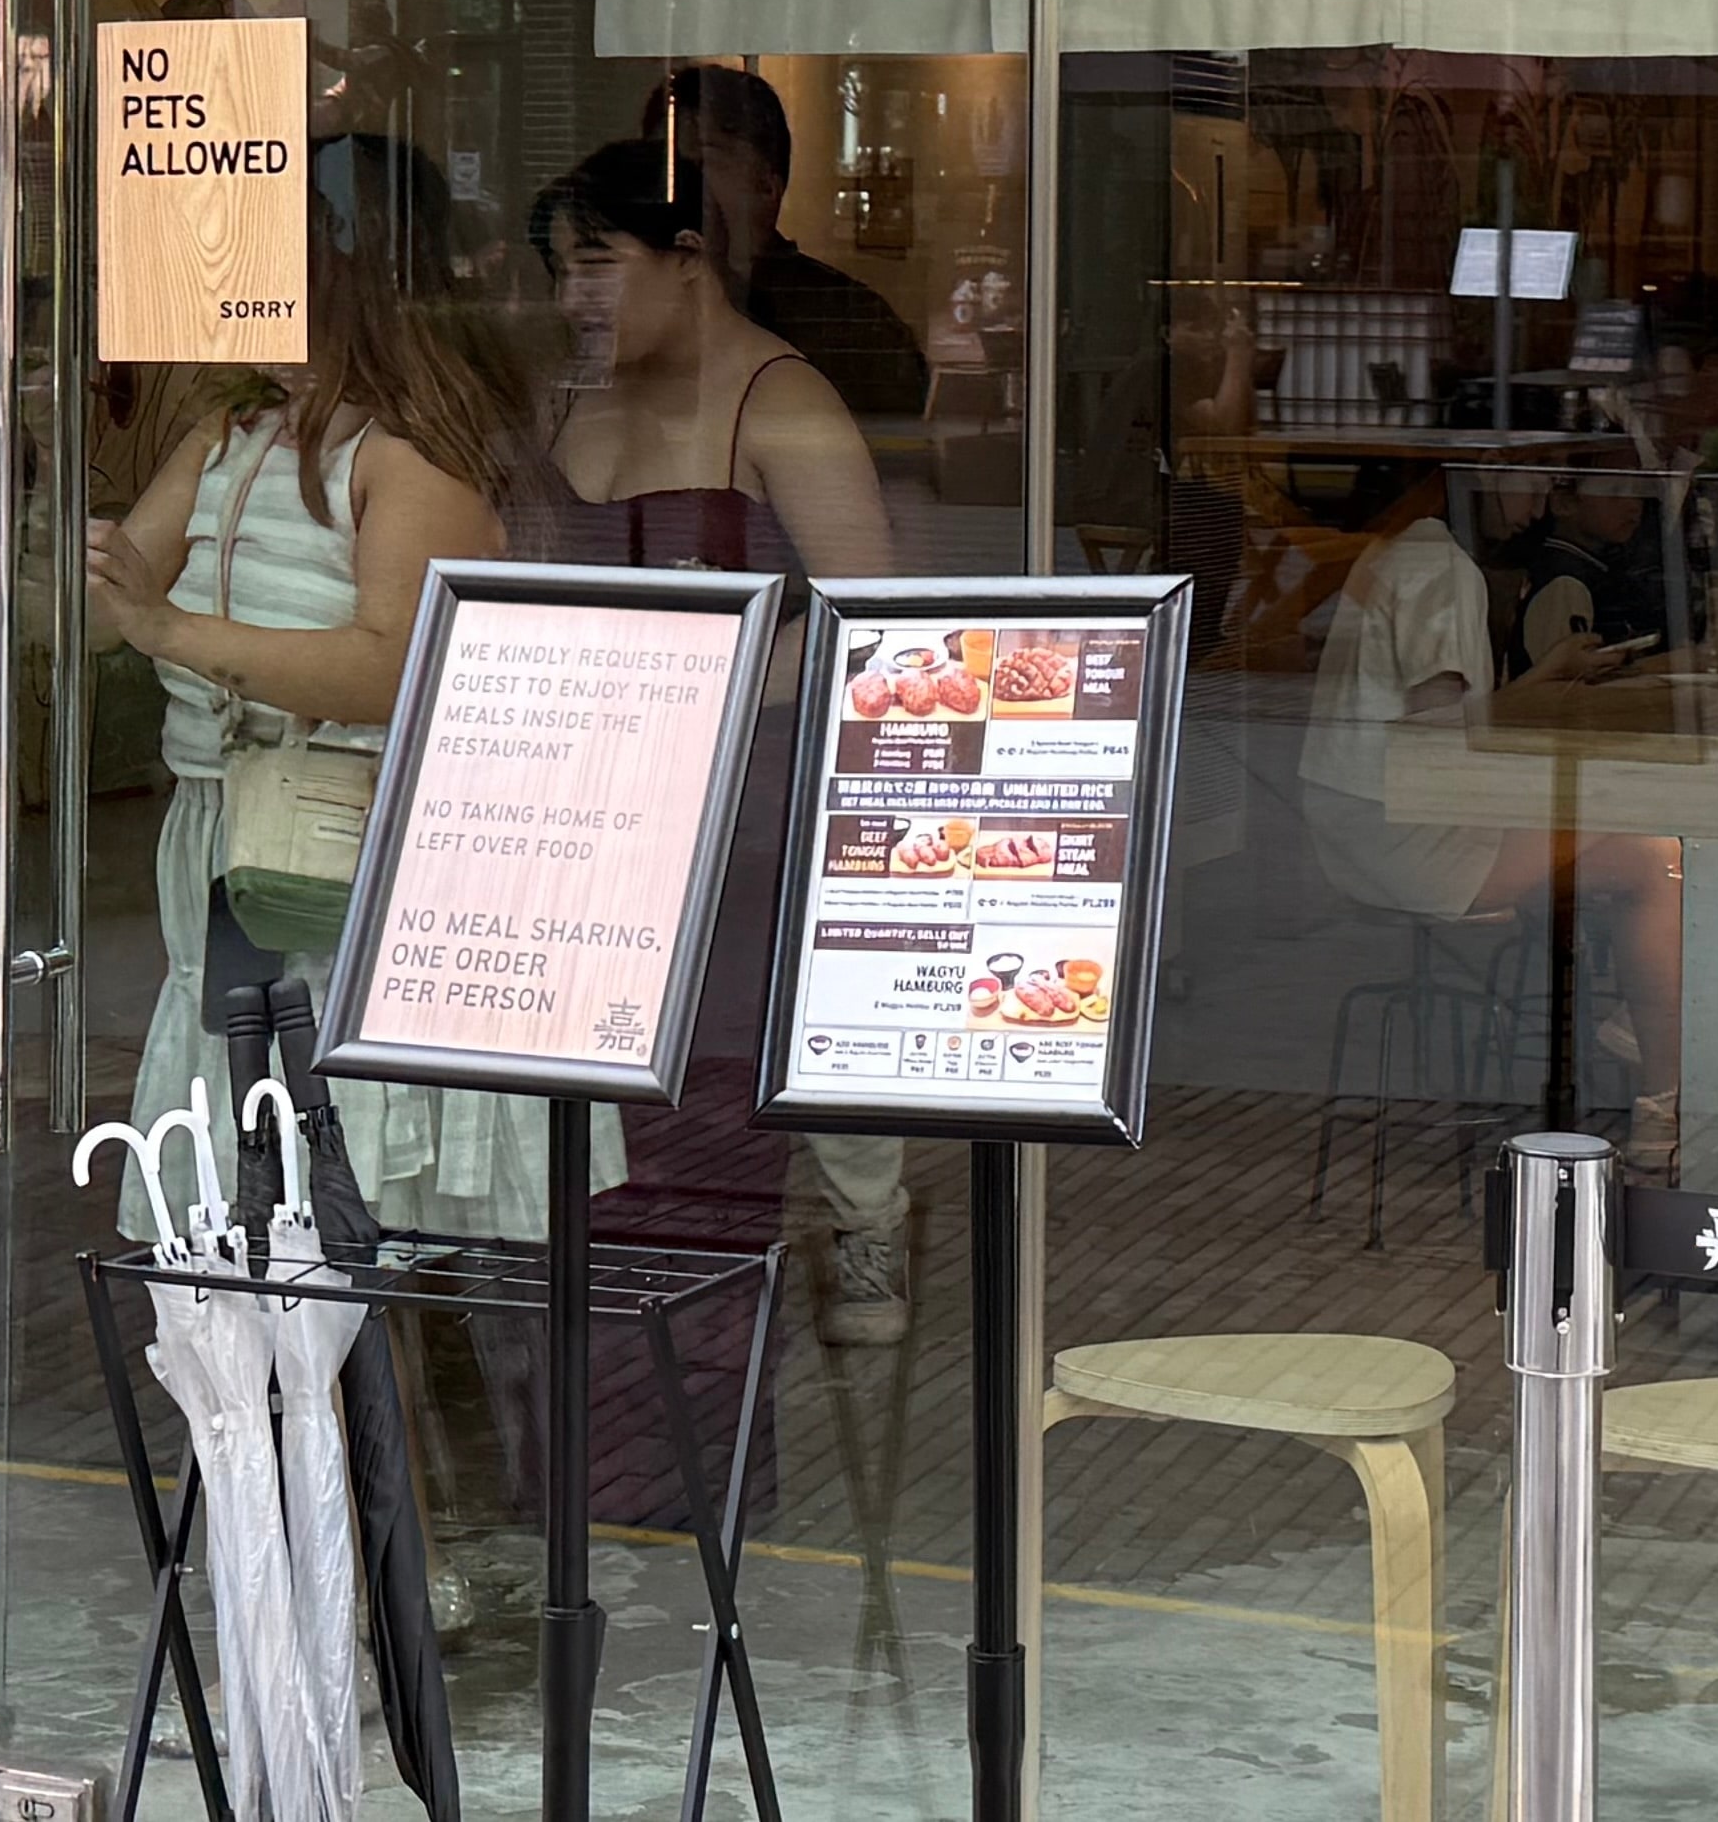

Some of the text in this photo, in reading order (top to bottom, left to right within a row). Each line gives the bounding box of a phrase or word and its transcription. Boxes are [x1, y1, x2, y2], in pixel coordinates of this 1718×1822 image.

[122, 48, 169, 83] NO
[123, 95, 206, 129] PETS
[121, 140, 288, 177] ALLOWED
[220, 300, 296, 319] SORRY
[460, 643, 727, 673] WE KINDLY REQUEST OUR
[452, 674, 698, 705] GUEST TO ENJOY THEIR
[445, 706, 642, 733] MEALS INSIDE THE
[880, 722, 949, 737] HAMBURG
[438, 737, 573, 761] RESTAURANT
[1003, 782, 1078, 797] UNLIMITED
[1080, 784, 1114, 797] RICE
[423, 801, 642, 830] NO TAKING HOME OF
[416, 834, 593, 860] LEFT OVER FOOD
[399, 909, 662, 953] NO MEAL SHARING,
[392, 944, 547, 977] ONE ORDER
[916, 965, 966, 979] WAGYU
[384, 979, 556, 1013] PER PERSON
[893, 978, 963, 994] HAMBURG
